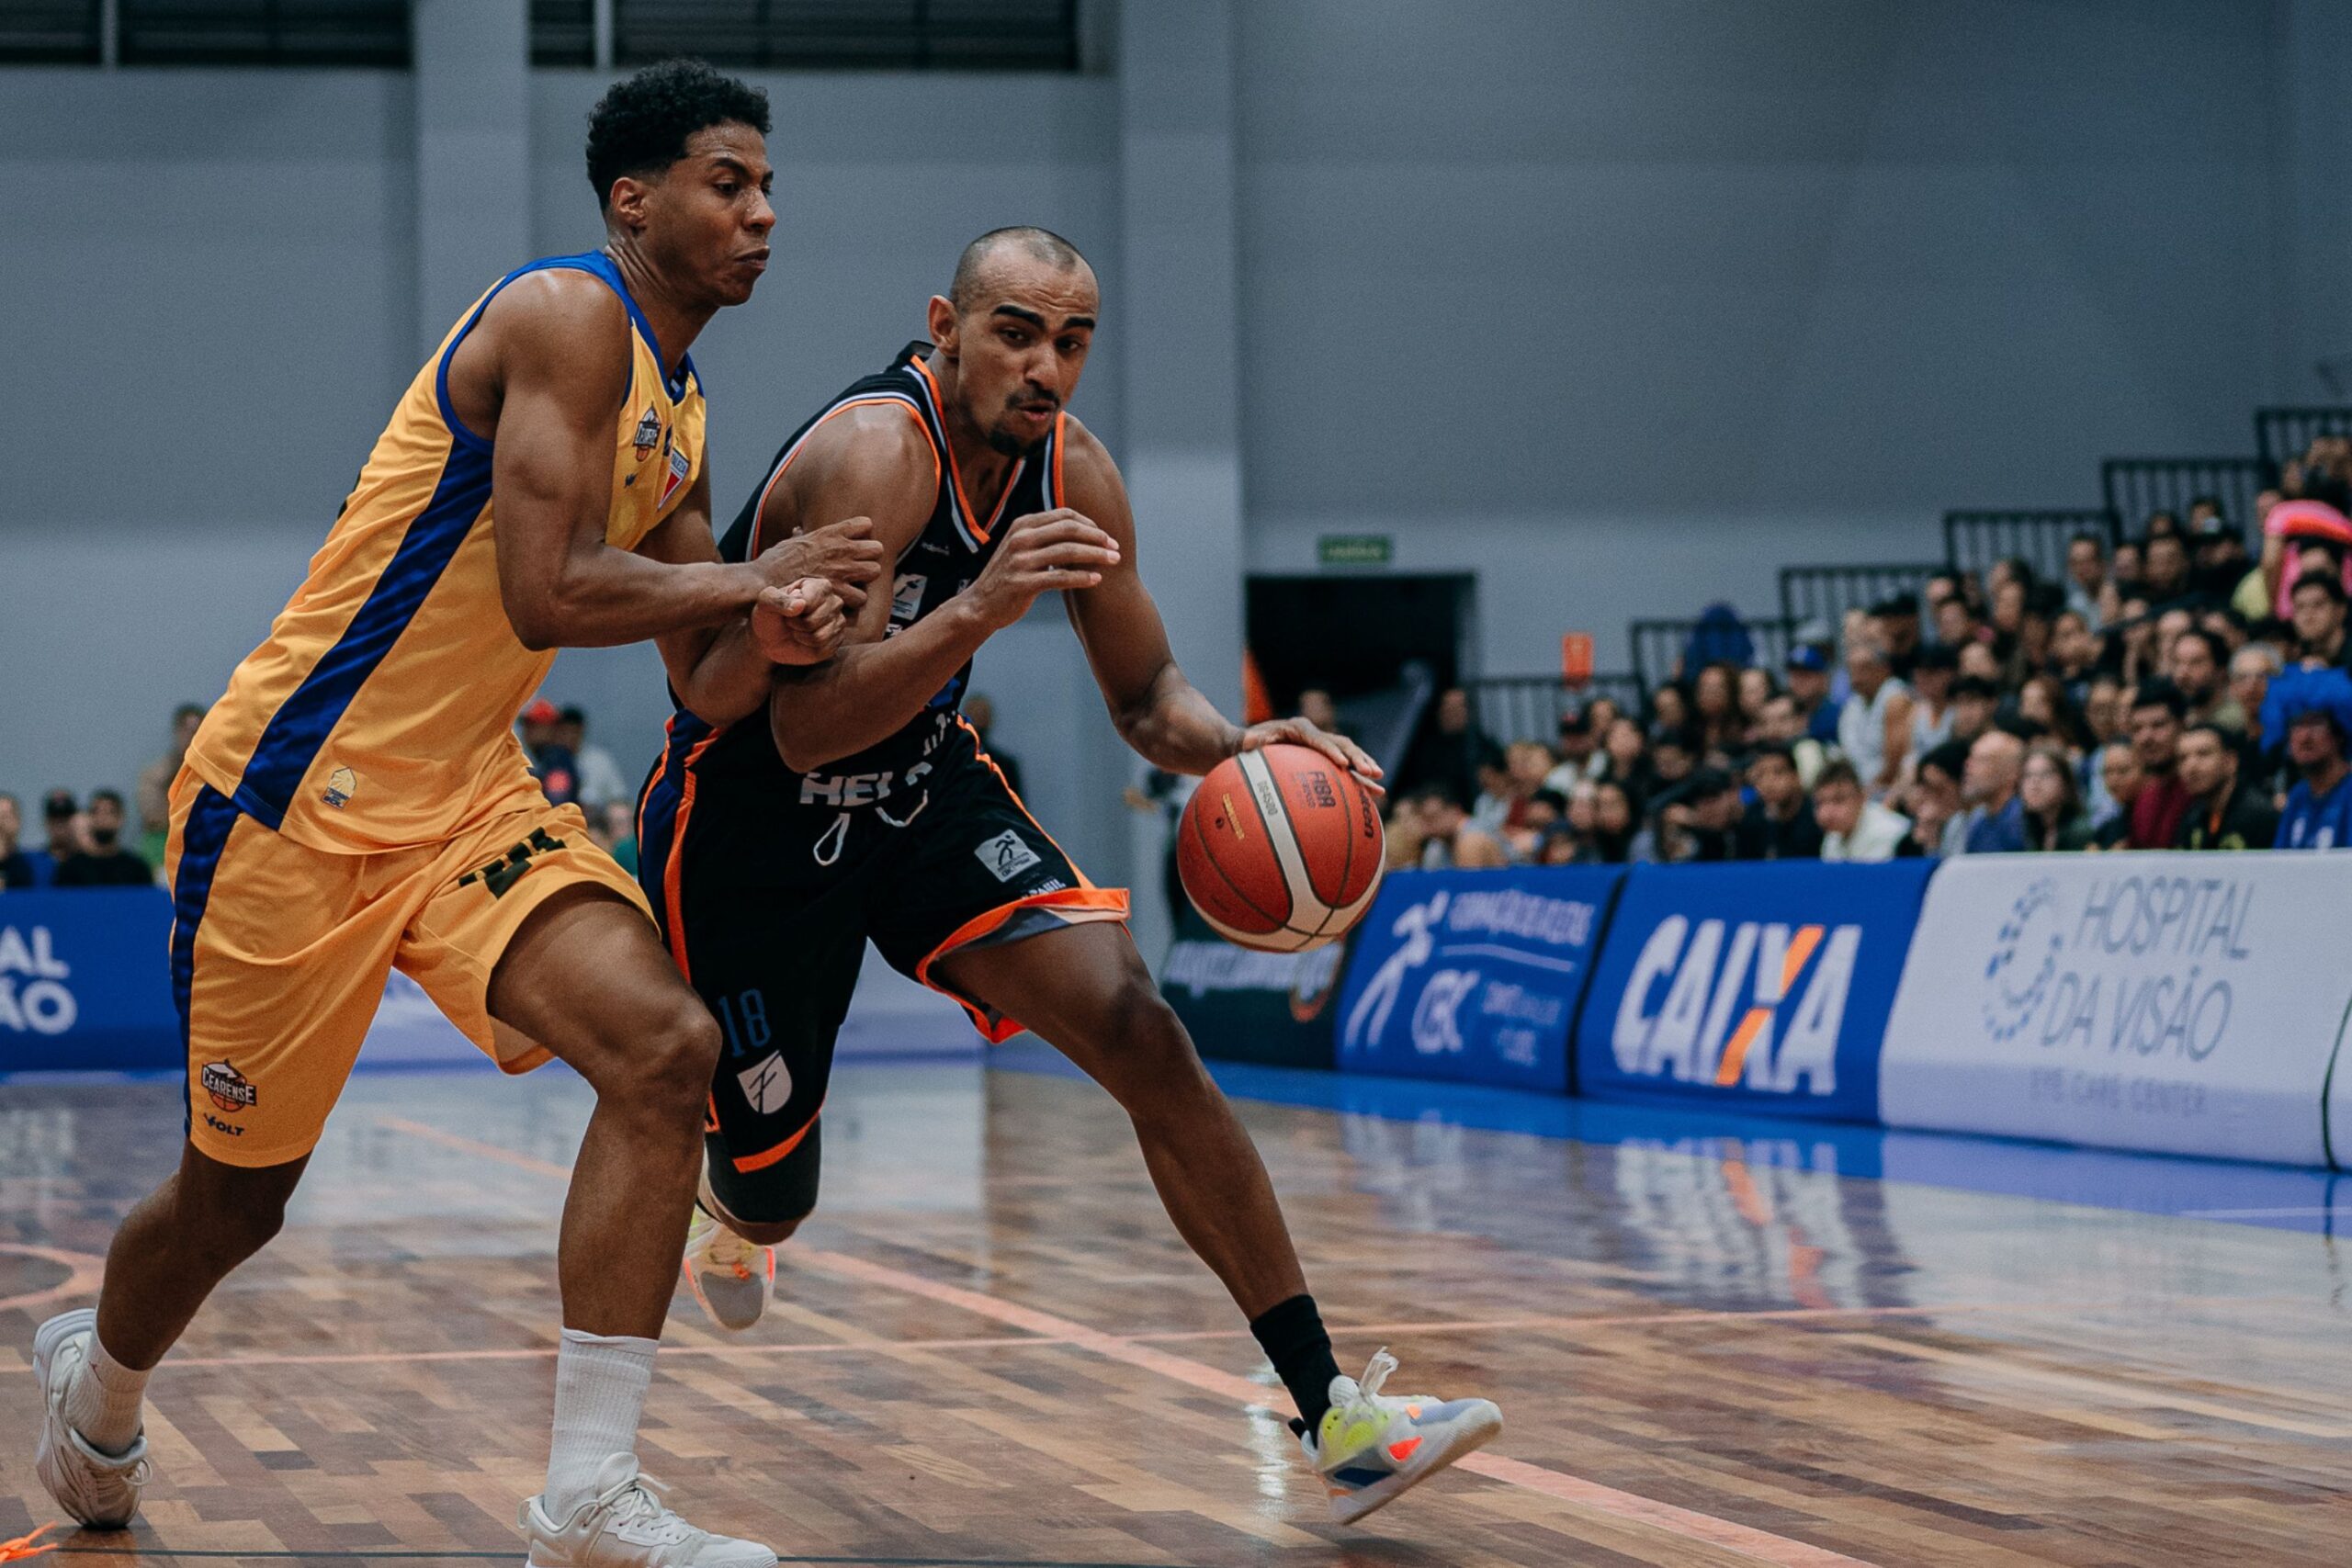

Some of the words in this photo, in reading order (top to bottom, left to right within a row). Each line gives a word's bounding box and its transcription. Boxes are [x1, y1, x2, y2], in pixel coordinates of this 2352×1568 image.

[2074, 875, 2254, 959] HOSPITAL
[718, 988, 770, 1057] 18
[1611, 914, 1862, 1096] CAIXA
[2041, 971, 2101, 1047] DA
[2109, 965, 2233, 1062] VISÃO
[202, 1066, 255, 1103] CEARENSE
[203, 1112, 244, 1136] VOLT
